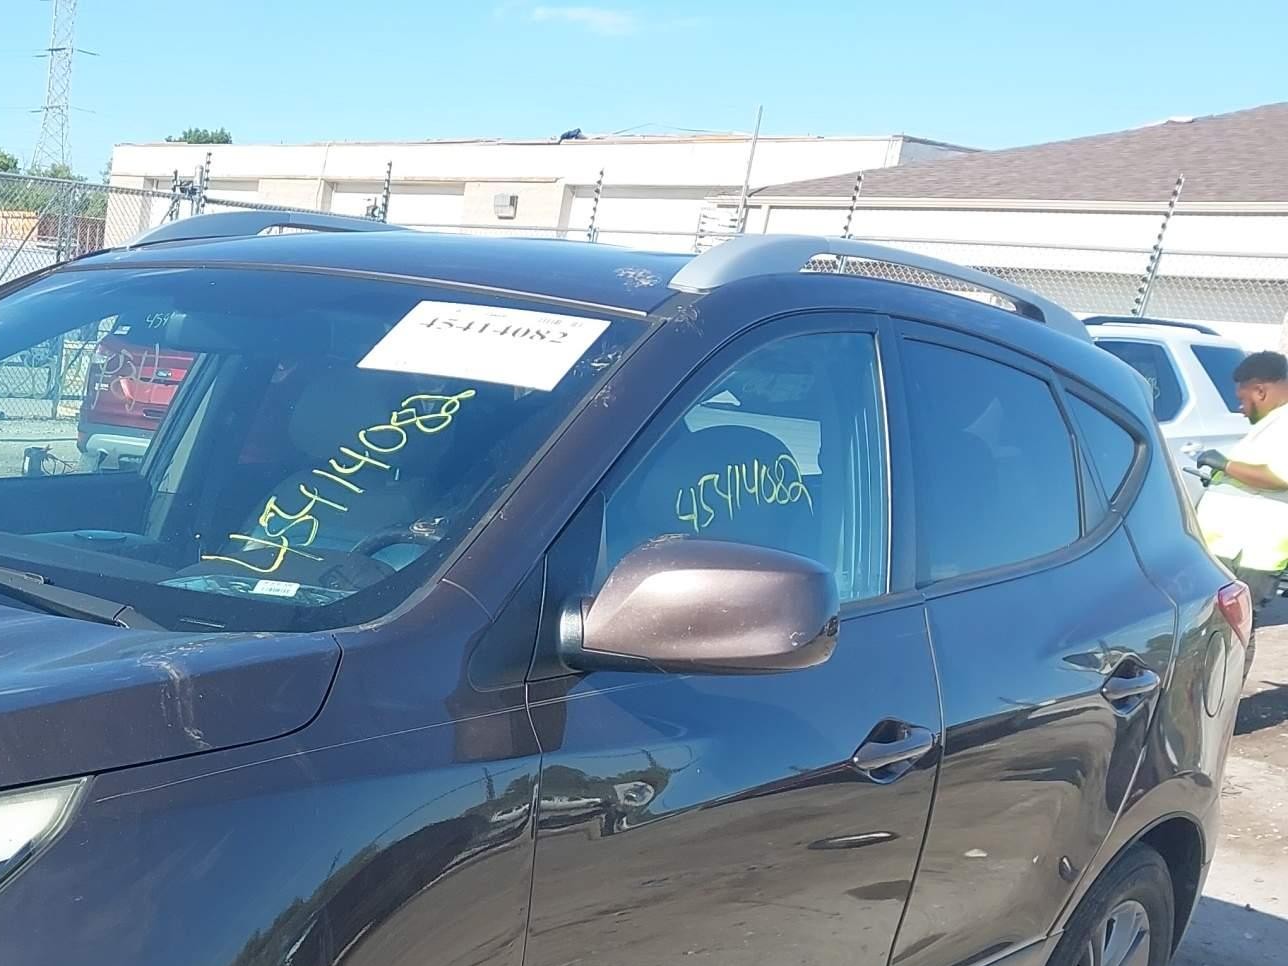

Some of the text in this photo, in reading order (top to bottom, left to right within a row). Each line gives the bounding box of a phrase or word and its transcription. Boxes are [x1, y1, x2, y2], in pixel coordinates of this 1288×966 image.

[418, 316, 569, 345] 45414082
[201, 389, 476, 573] 45414082
[675, 454, 814, 534] 45414082
